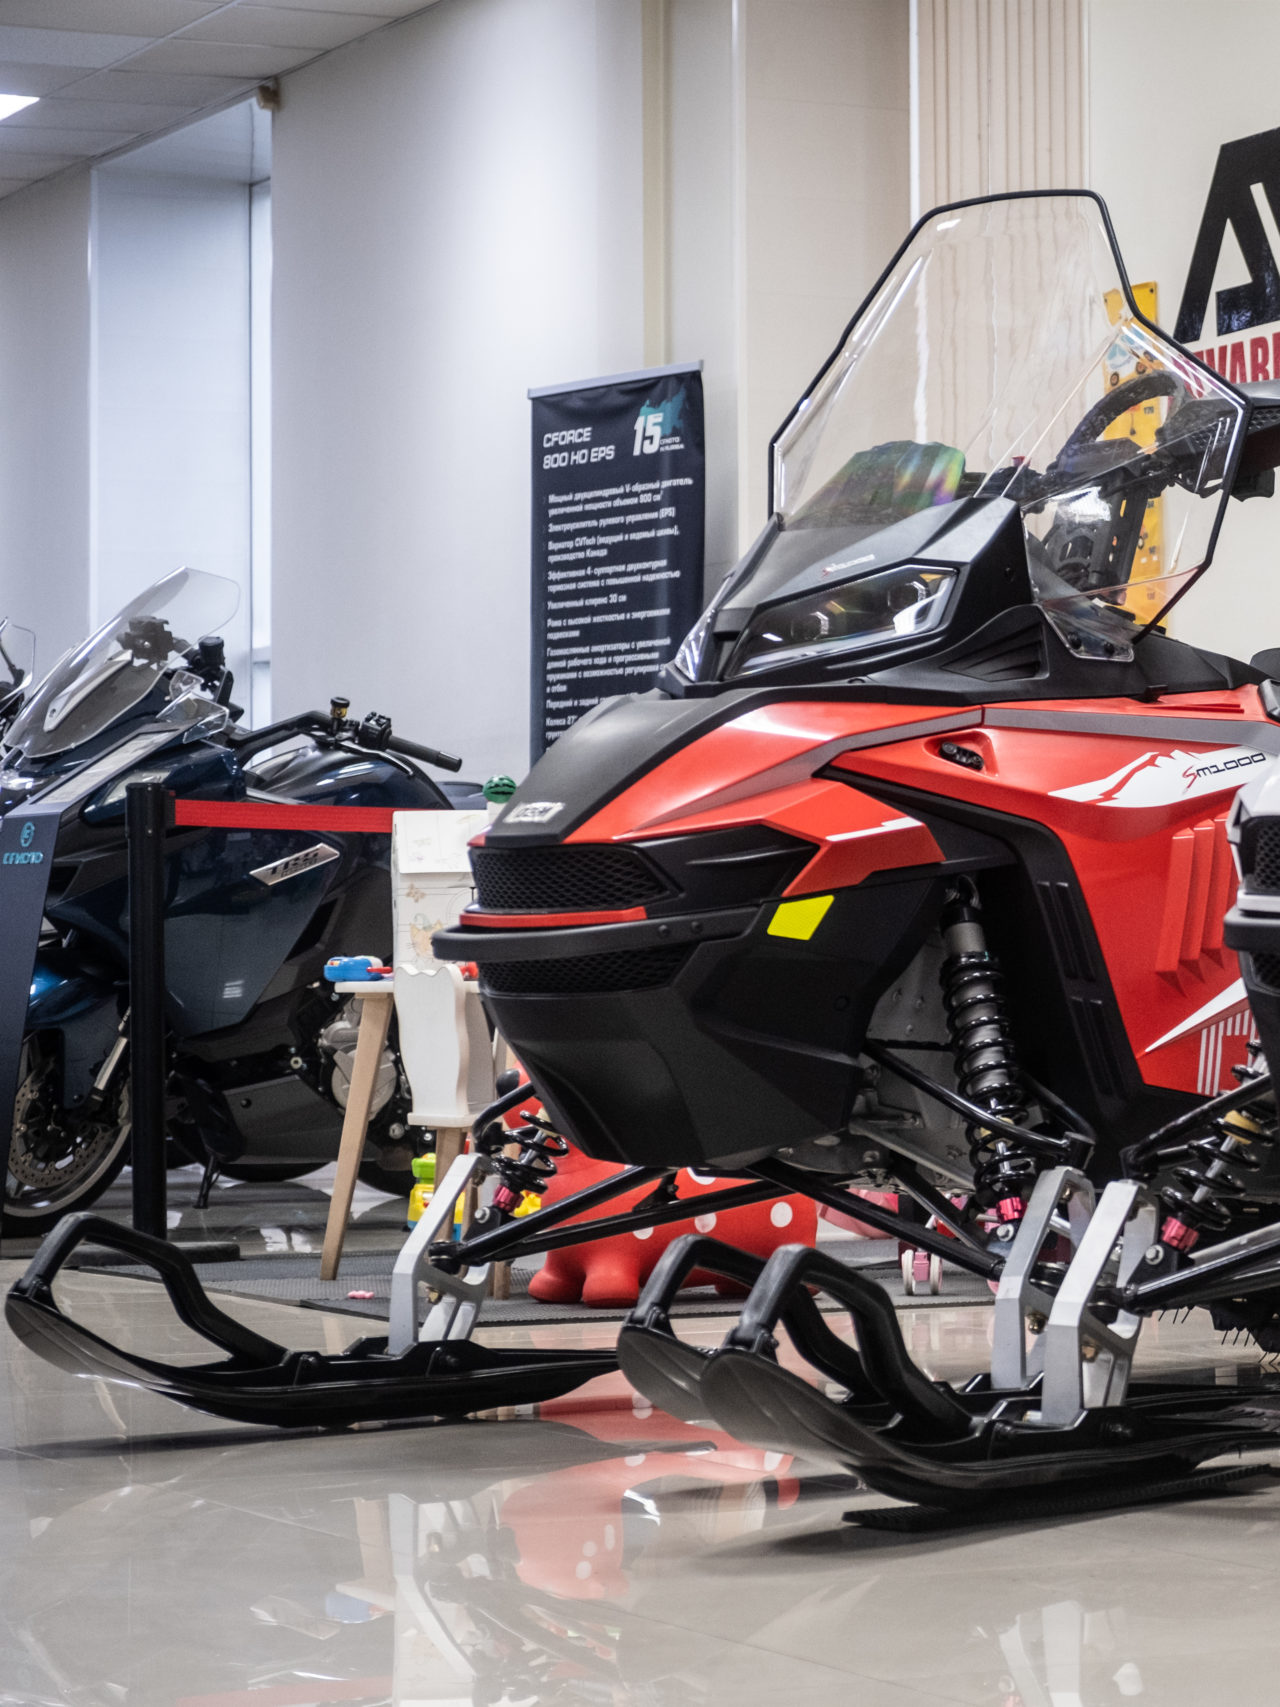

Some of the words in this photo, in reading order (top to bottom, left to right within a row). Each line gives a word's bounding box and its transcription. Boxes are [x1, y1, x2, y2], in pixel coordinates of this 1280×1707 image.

[543, 427, 592, 448] CFORCE
[633, 412, 664, 456] 15
[543, 452, 569, 470] 800
[570, 449, 588, 466] HO
[590, 445, 615, 463] EPS
